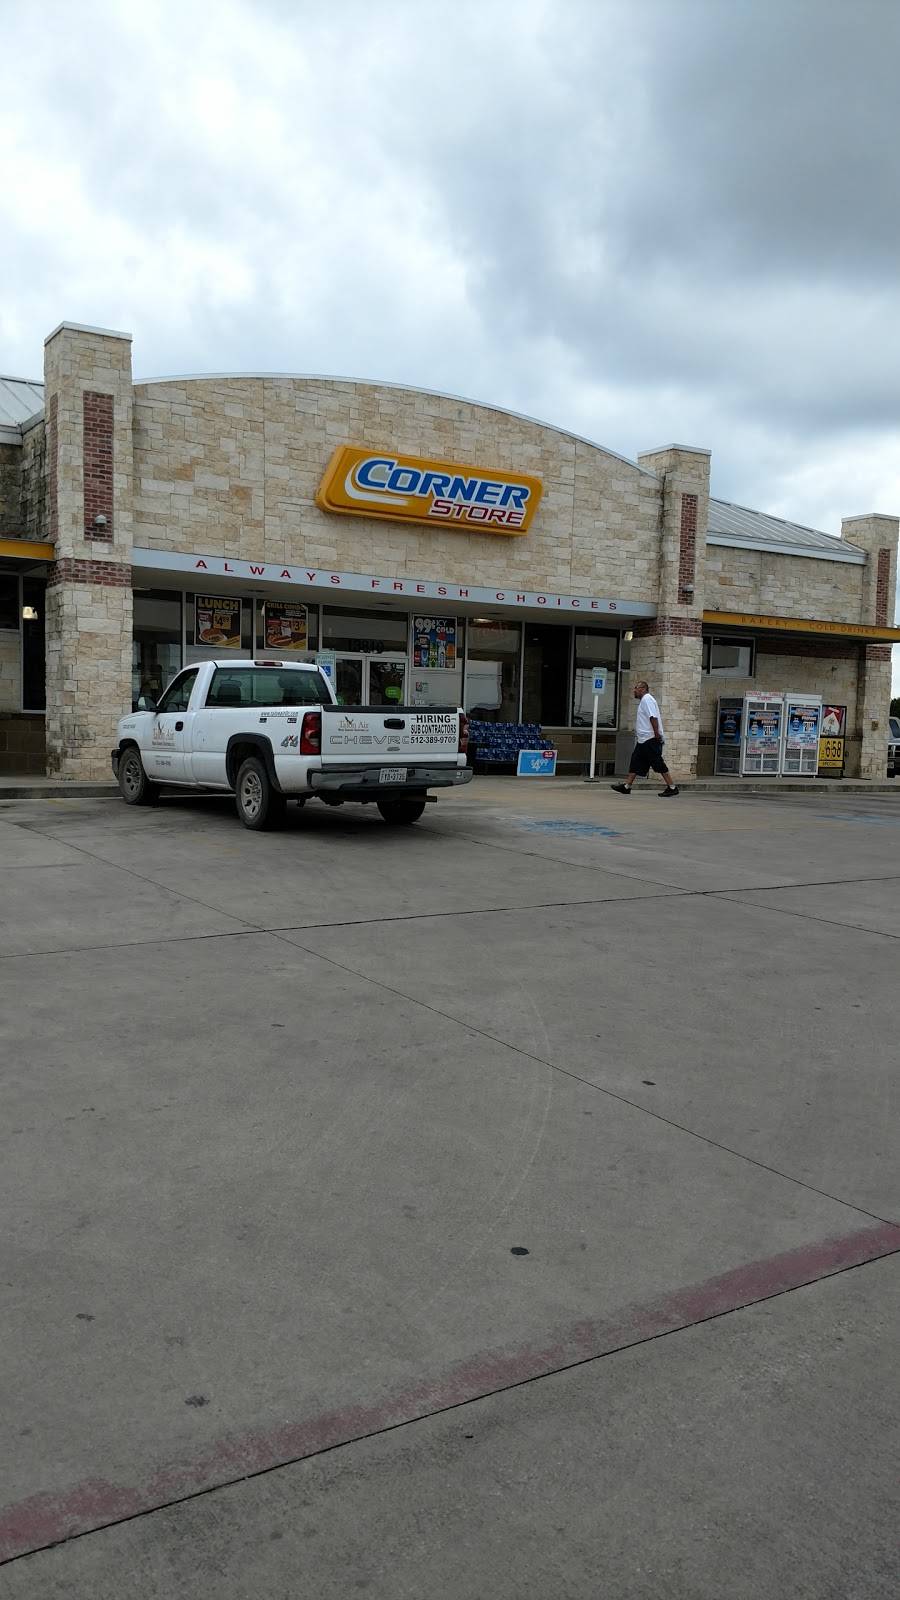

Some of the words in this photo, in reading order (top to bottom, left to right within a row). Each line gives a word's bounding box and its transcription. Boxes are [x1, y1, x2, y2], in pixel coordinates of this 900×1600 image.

[355, 457, 531, 511] CORNER
[430, 498, 524, 526] STORE
[195, 559, 341, 585] ALWAYS
[371, 579, 469, 598] FRESH
[496, 592, 617, 611] CHOICES
[198, 598, 239, 610] LUNCH
[436, 626, 455, 634] COLD
[809, 623, 835, 632] COLD
[416, 714, 451, 724] HIRING
[410, 724, 421, 735] SUB
[421, 724, 457, 735] CONTRACTORS
